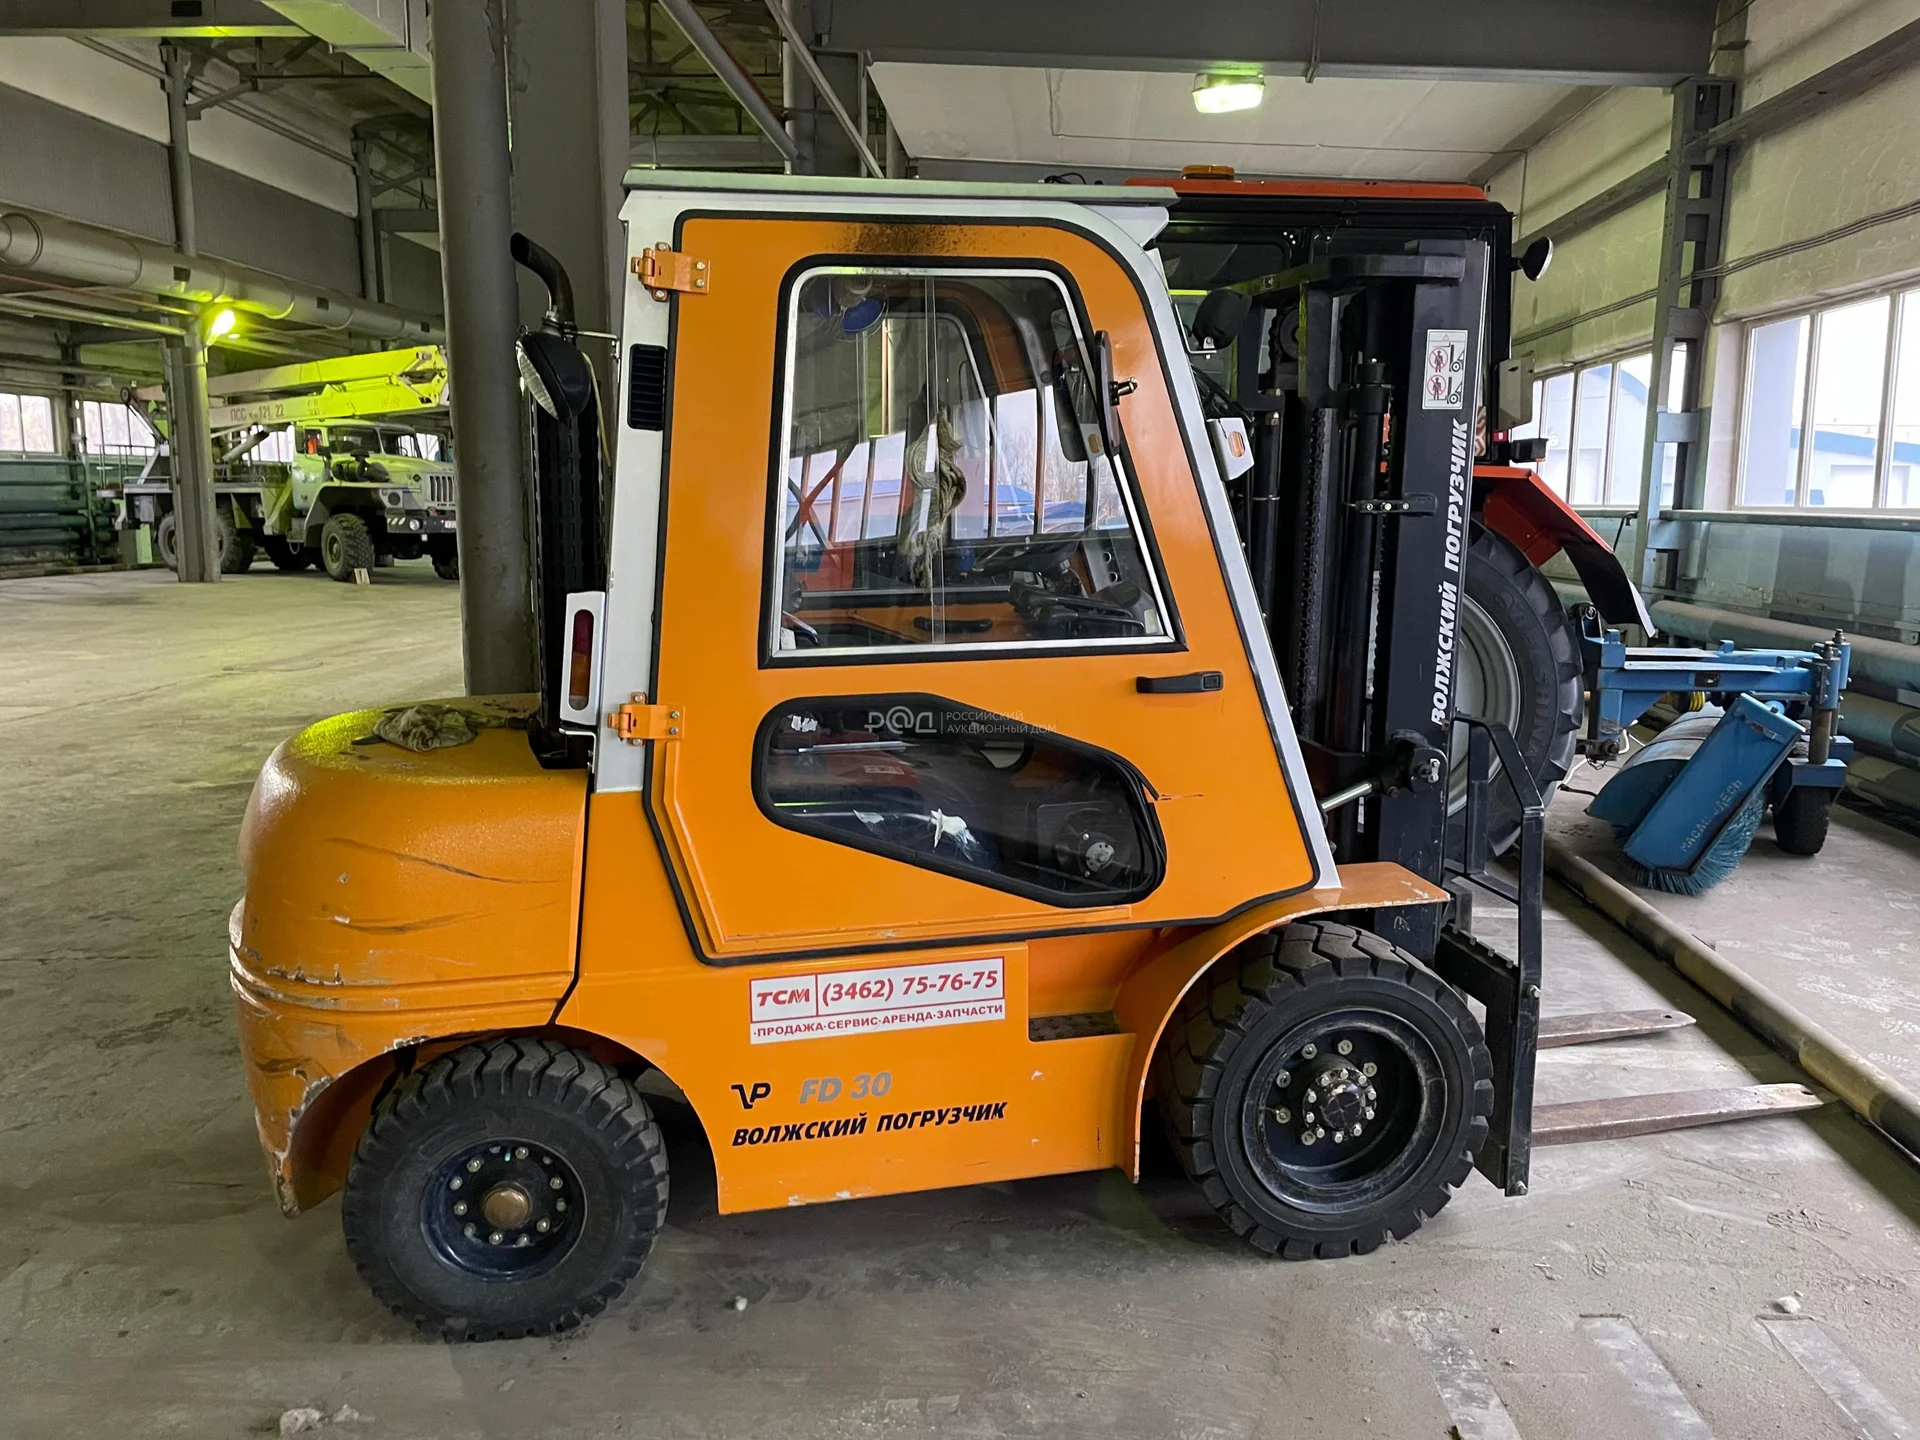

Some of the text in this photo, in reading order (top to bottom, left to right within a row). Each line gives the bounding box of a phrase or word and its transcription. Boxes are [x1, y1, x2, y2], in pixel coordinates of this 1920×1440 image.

[1431, 418, 1468, 726] ВОЛЖСКИЙ ПОГРУЗЧИК
[822, 977, 894, 1008] (3462)
[902, 970, 998, 996] 75-76-75
[799, 1071, 892, 1104] FD 30
[732, 1102, 1008, 1147] ВОЛЖСКИЙ ПОГРУЗЧИК
